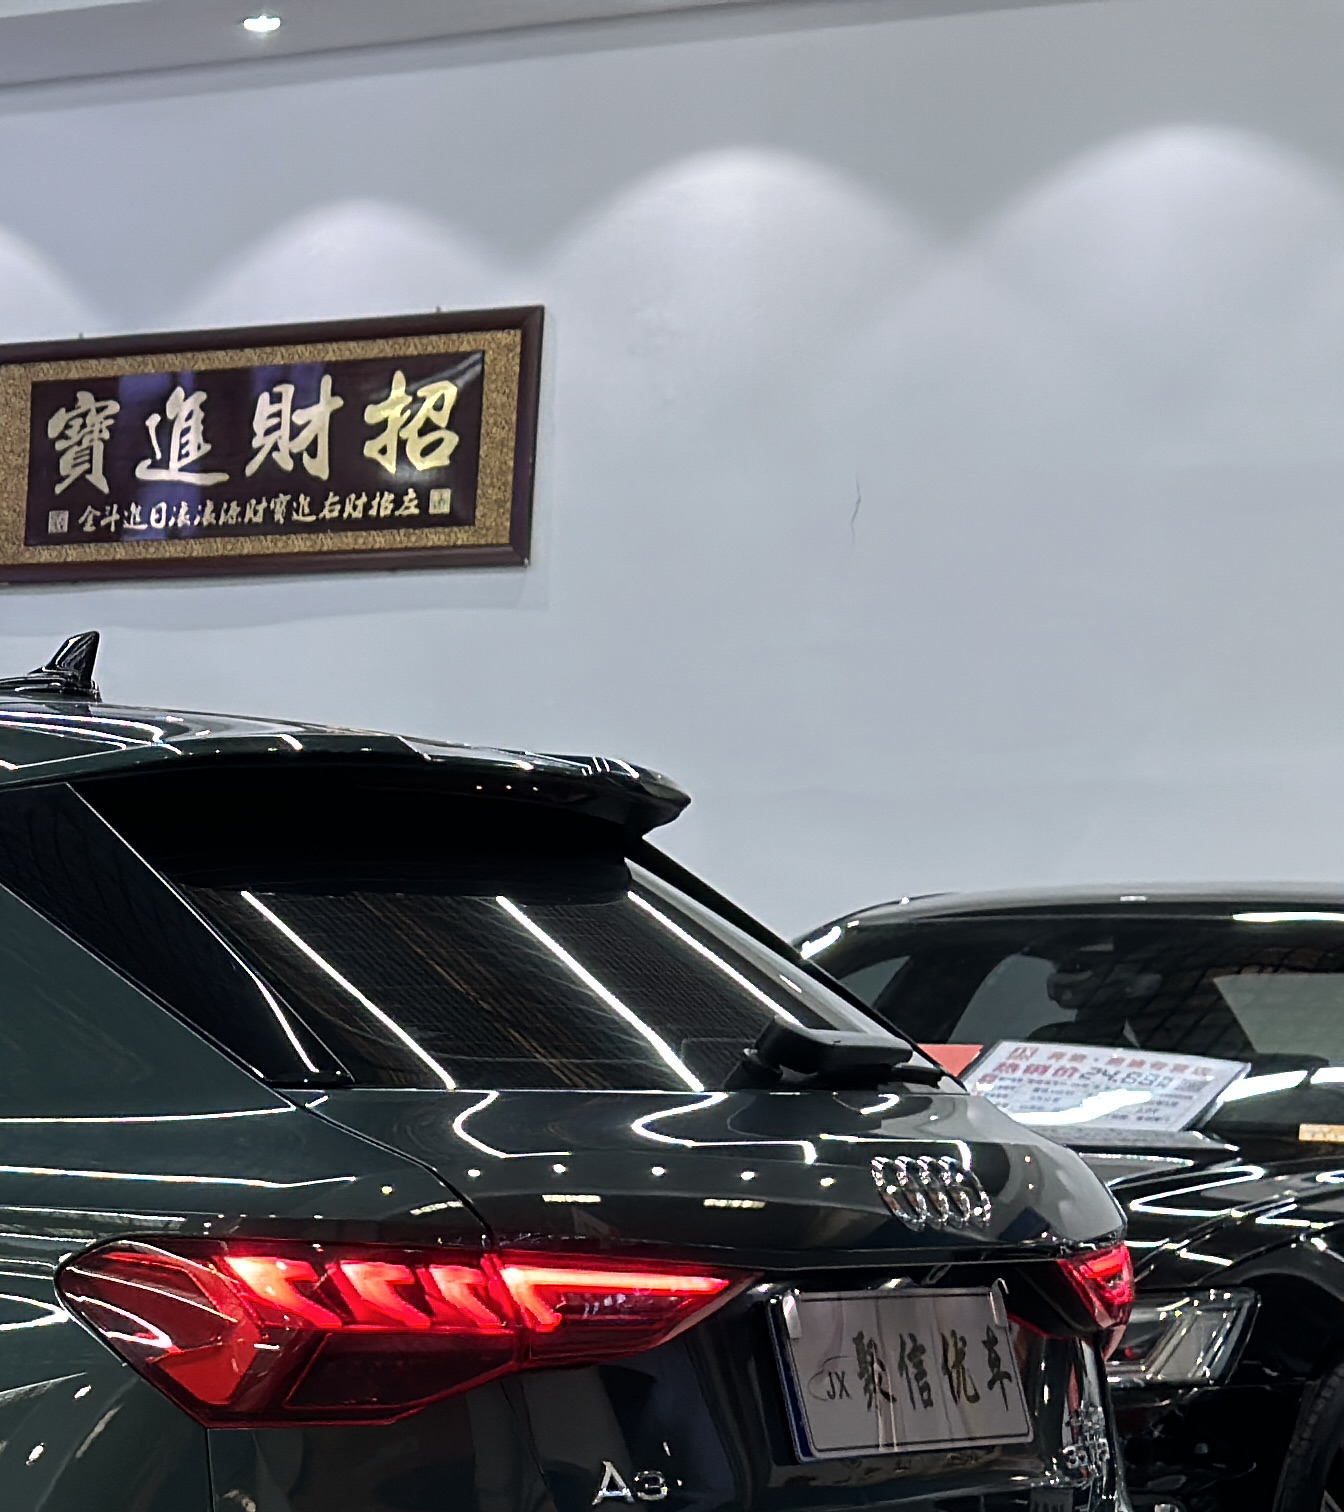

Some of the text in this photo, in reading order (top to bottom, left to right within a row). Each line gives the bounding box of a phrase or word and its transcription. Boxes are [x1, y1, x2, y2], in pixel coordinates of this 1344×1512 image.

[852, 1325, 1013, 1412] 聚信优车
[592, 1460, 668, 1505] A3
